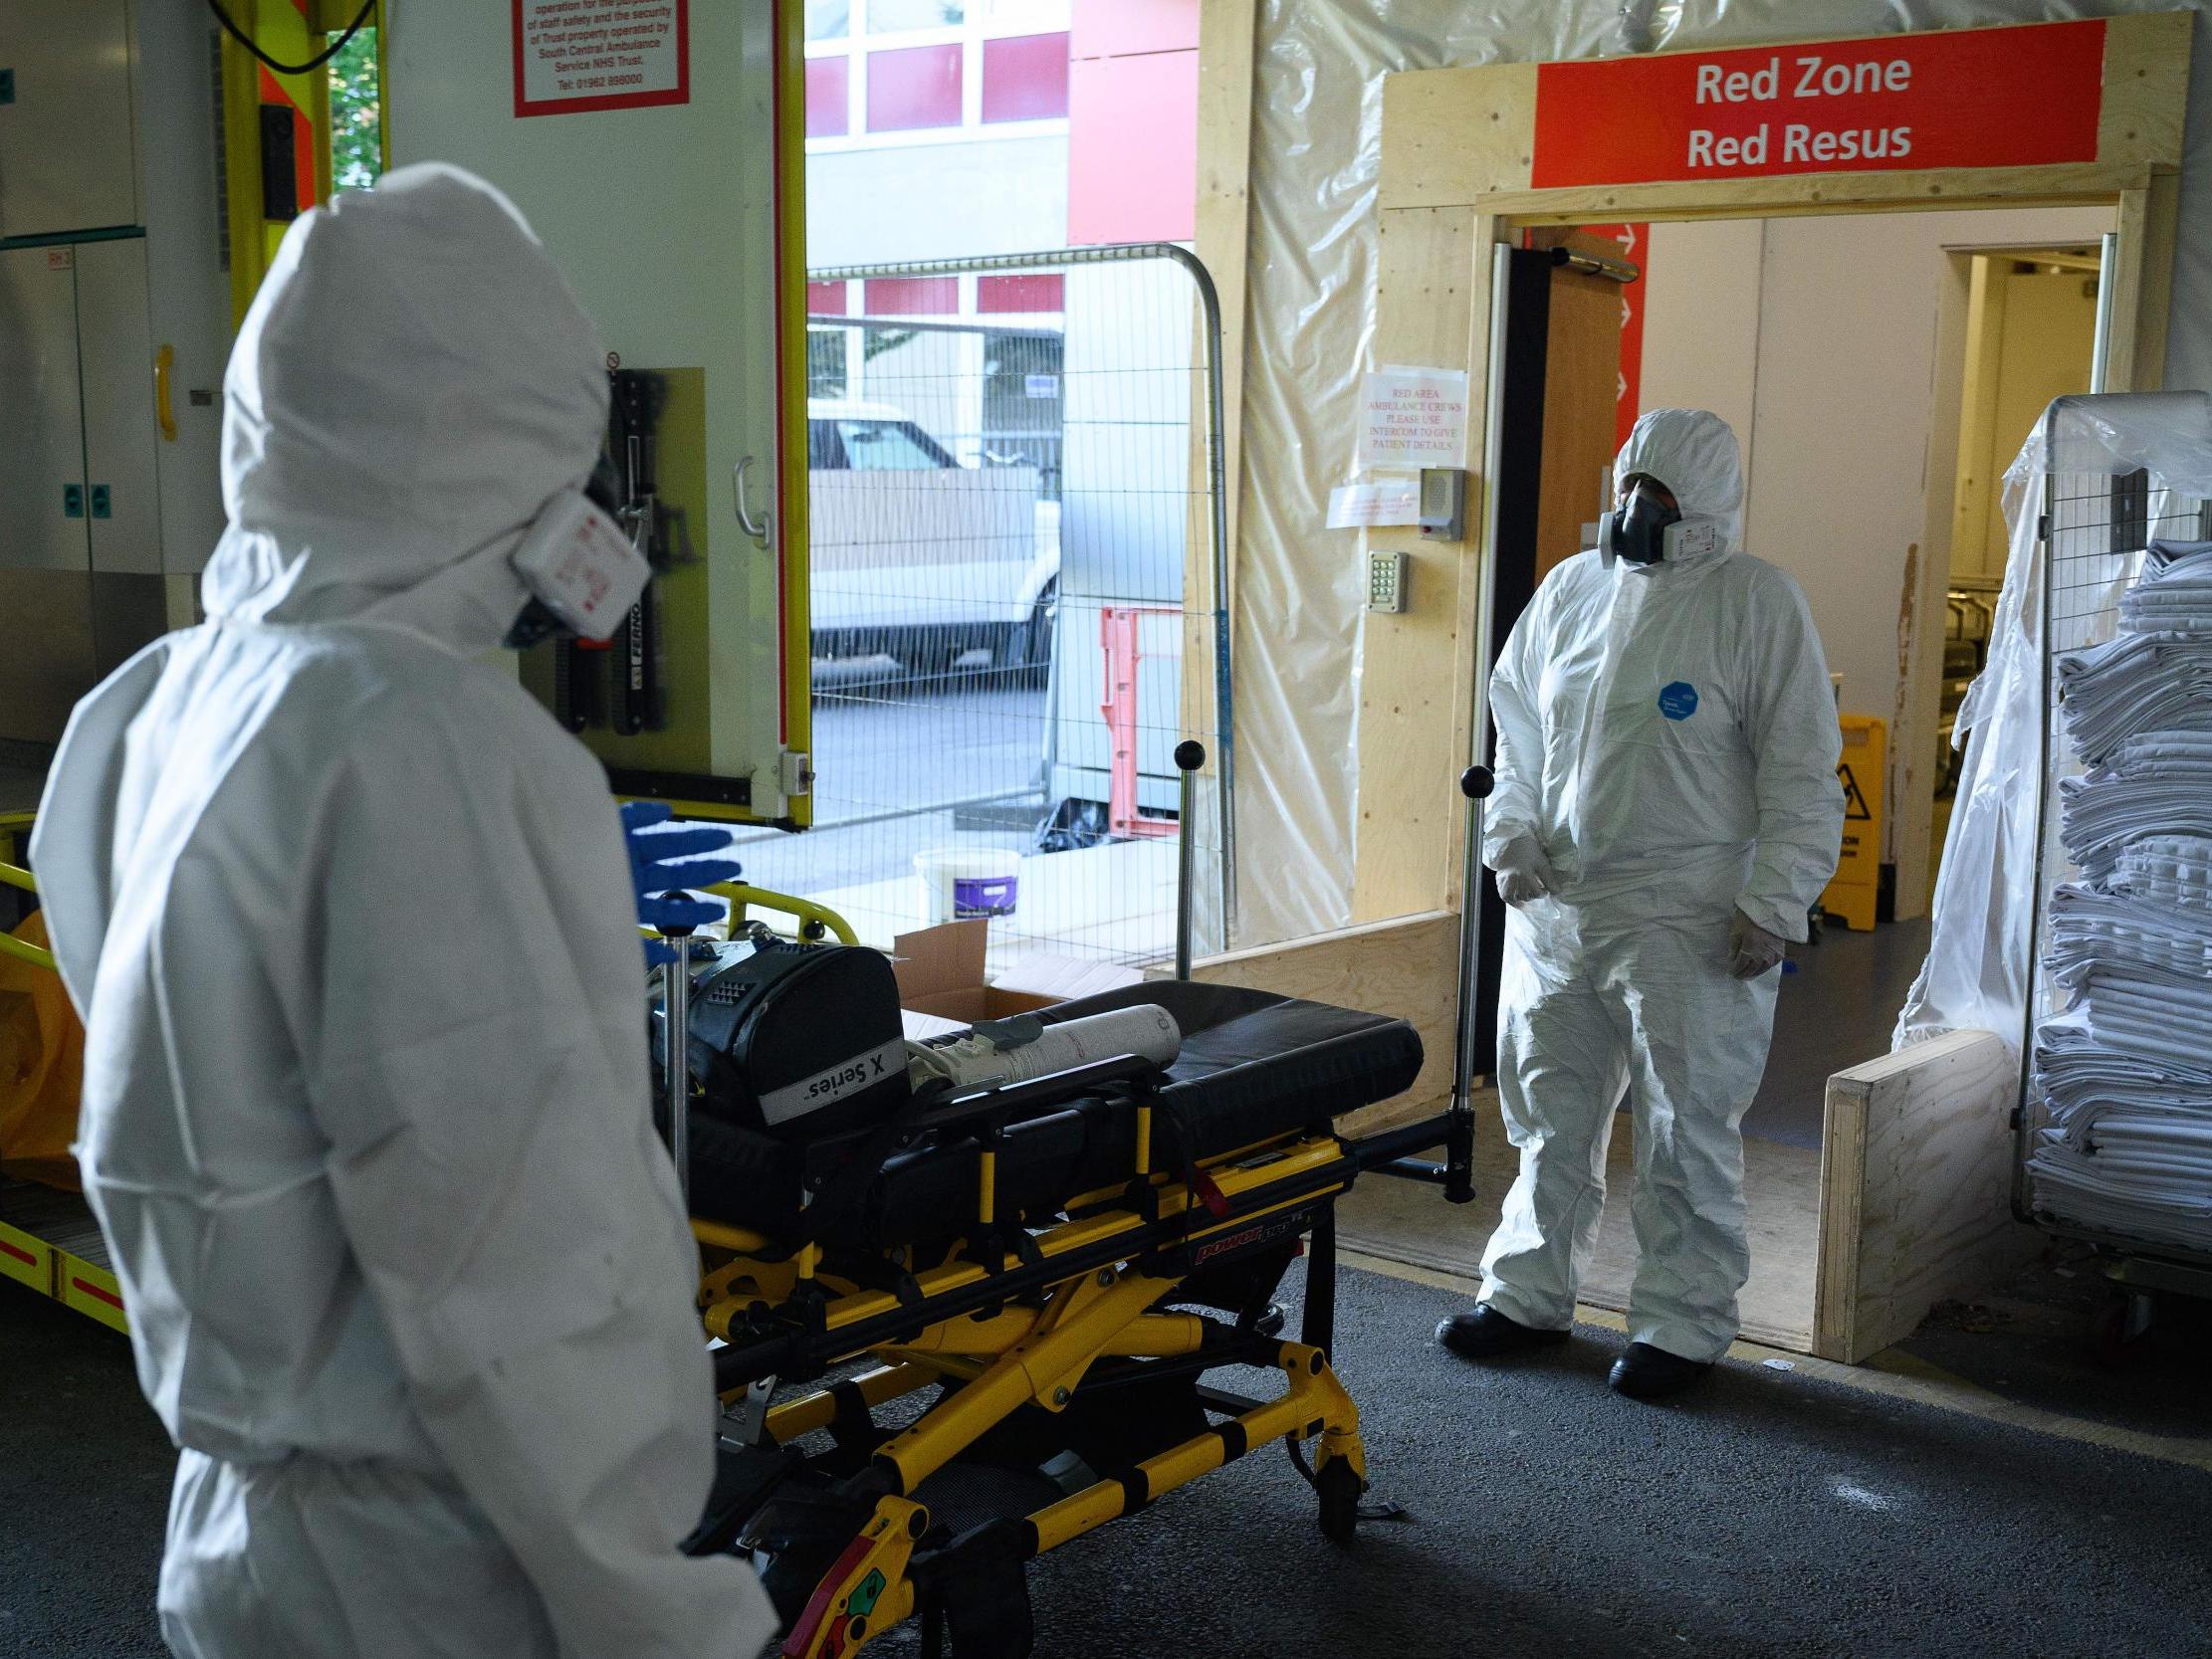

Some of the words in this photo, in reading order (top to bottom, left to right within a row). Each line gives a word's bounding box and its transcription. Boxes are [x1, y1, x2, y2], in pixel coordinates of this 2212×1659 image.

[528, 20, 538, 30] of
[541, 17, 560, 29] staff
[563, 15, 590, 27] safety
[593, 12, 611, 23] and
[614, 11, 630, 21] the
[632, 7, 671, 19] security
[535, 2, 580, 15] operation
[530, 34, 540, 45] of
[543, 32, 565, 43] Trust
[568, 30, 607, 43] property
[611, 24, 654, 38] operated
[656, 22, 669, 34] by
[539, 47, 566, 59] South
[569, 43, 603, 56] Central
[607, 40, 661, 51] Ambulance
[554, 61, 590, 73] Service
[593, 57, 615, 69] NHS
[617, 55, 643, 66] Trust
[1696, 58, 1778, 104] Red
[1795, 58, 1910, 97] Zone
[1688, 124, 1767, 166] Red
[1784, 124, 1910, 162] Resus
[1393, 389, 1412, 399] RED
[1414, 389, 1440, 399] AREA
[1370, 401, 1425, 411] AMBULANCE
[1428, 402, 1462, 412] CREWS
[1386, 414, 1421, 424] PLEASE
[1423, 415, 1440, 425] USE
[1373, 439, 1411, 449] PATIENT
[631, 603, 641, 657] FERNO
[870, 1054, 885, 1076] X
[1194, 1225, 1263, 1266] power
